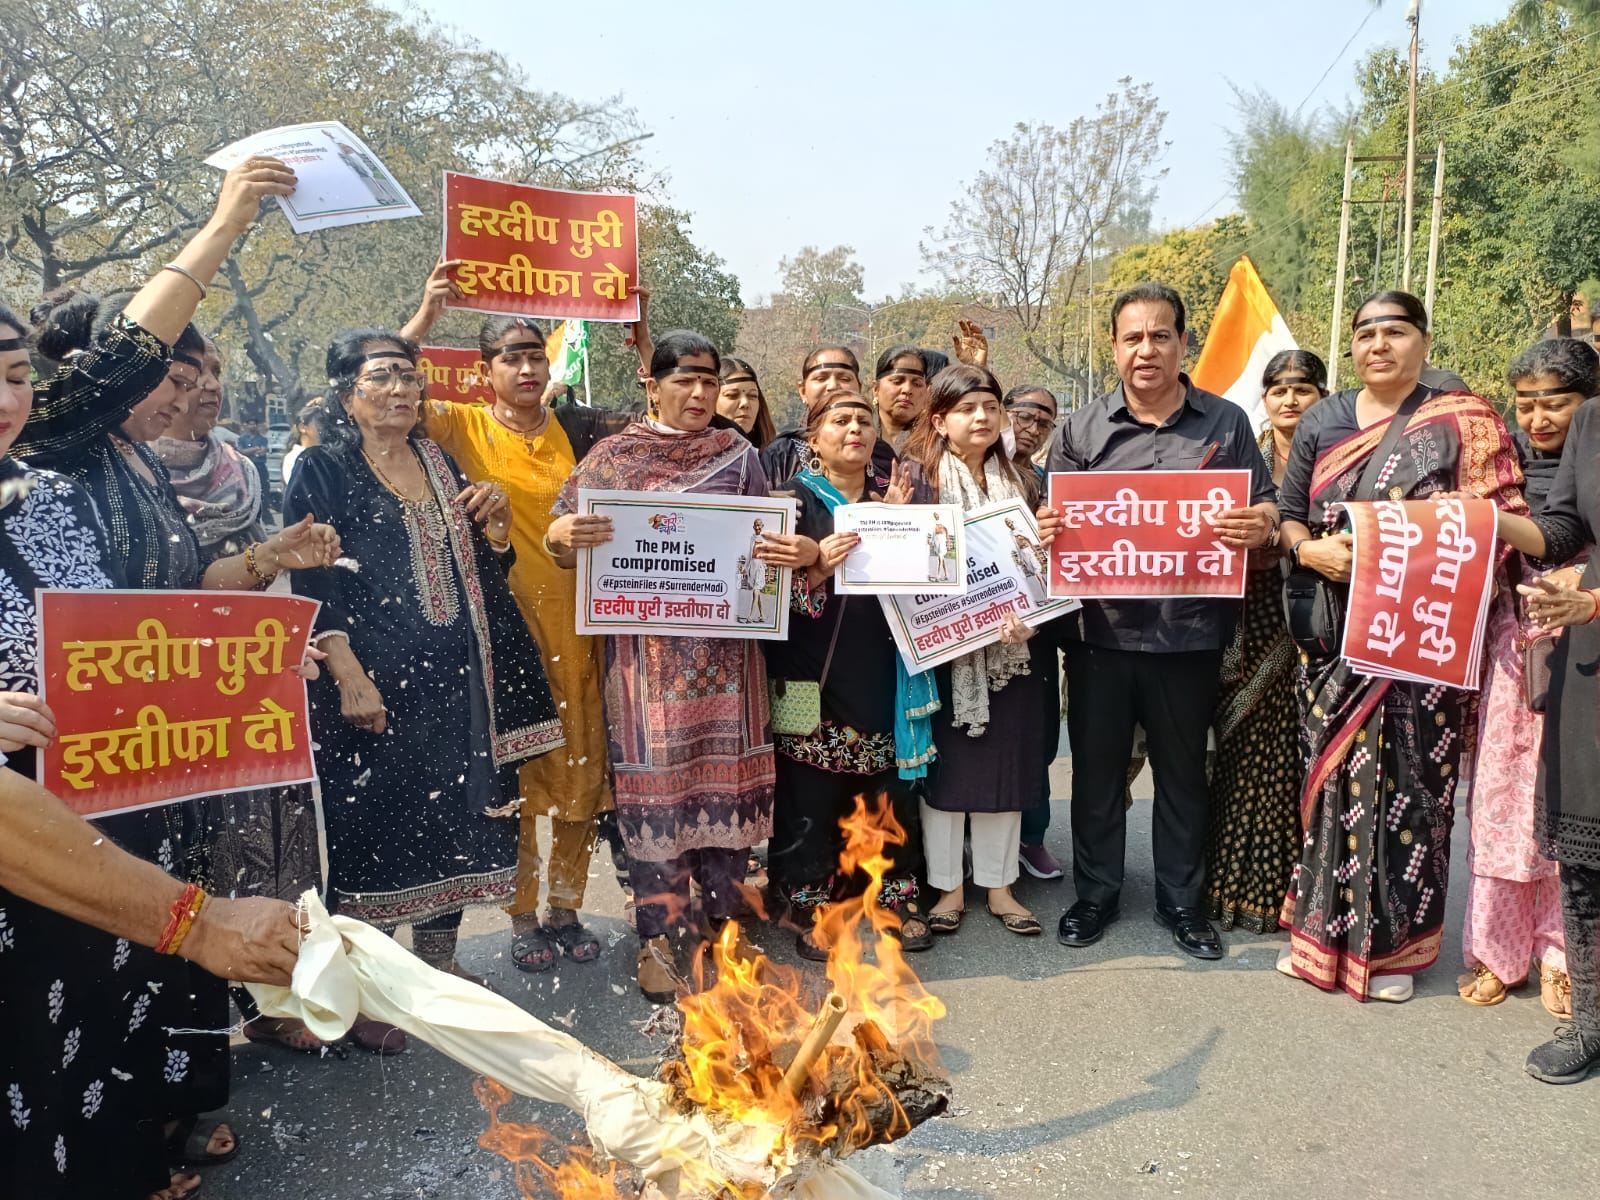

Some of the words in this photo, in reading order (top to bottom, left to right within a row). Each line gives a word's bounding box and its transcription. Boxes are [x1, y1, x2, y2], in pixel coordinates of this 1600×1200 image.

[458, 200, 560, 244] हरदीप
[568, 210, 623, 259] पुरी
[456, 254, 583, 298] इस्तीफा
[591, 262, 630, 300] दो
[1062, 487, 1168, 528] हरदीप
[1176, 487, 1235, 538] पुरी
[611, 555, 716, 573] compromised
[635, 539, 658, 553] The
[661, 540, 681, 554] PM
[684, 540, 695, 555] is
[1059, 538, 1188, 582] इस्तीफा
[1196, 541, 1237, 576] दो
[1373, 500, 1423, 604] स्तीफा
[1430, 499, 1476, 593] रदीप
[593, 595, 635, 615] हरदीप
[638, 596, 662, 621] पुरी
[664, 598, 715, 619] इस्तीफा
[715, 599, 731, 620] दो
[602, 578, 658, 591] #EpsteinFiles
[659, 580, 723, 593] #SurrenderModi
[914, 600, 961, 626] #EpsteinFiles
[961, 579, 1015, 608] #SurrenderModi
[914, 623, 952, 651] हरदीप
[950, 613, 974, 641] पुरी
[1015, 592, 1031, 610] दो
[1366, 611, 1405, 657] दो
[1412, 596, 1456, 666] पुरी
[62, 618, 202, 691] हरदीप
[215, 618, 290, 695] पुरी
[59, 704, 231, 790] इस्तीफा
[241, 698, 296, 753] दो
